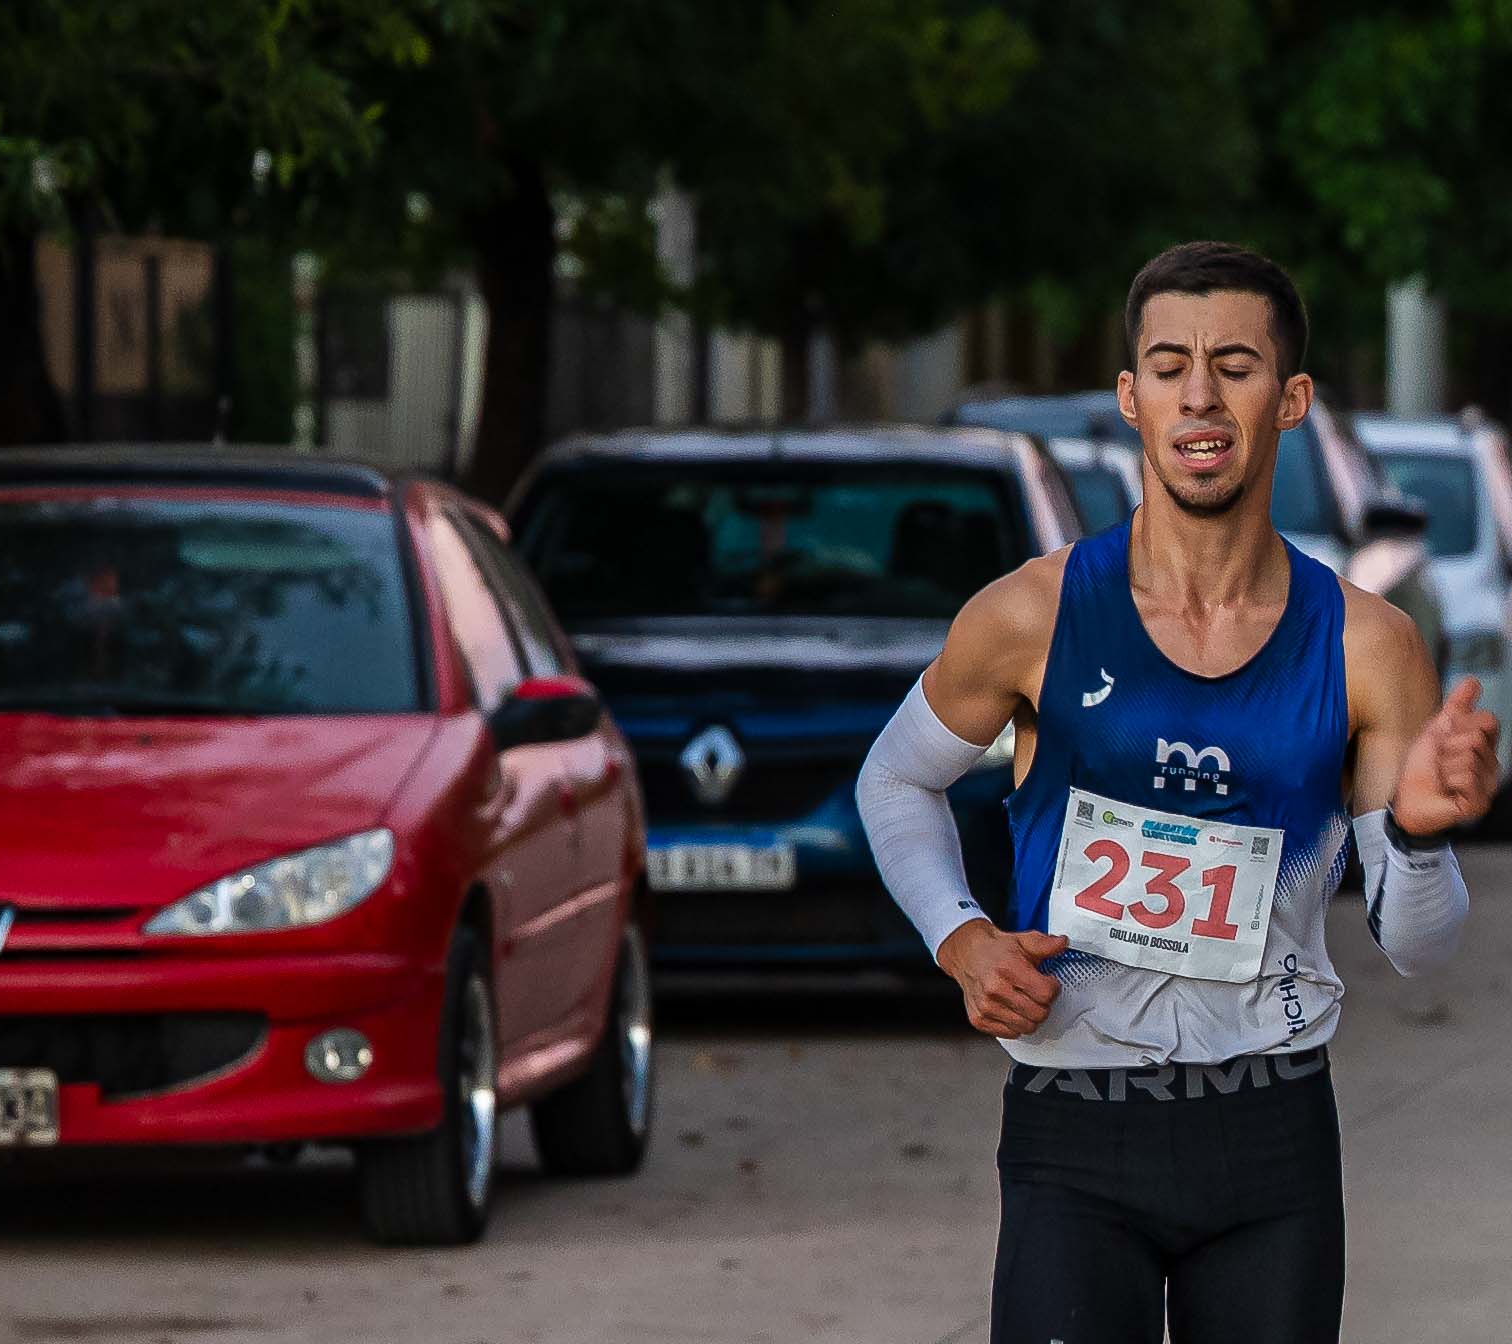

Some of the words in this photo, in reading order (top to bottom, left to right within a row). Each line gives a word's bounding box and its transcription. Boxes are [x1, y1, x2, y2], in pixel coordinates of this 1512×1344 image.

[1161, 766, 1221, 783] running
[1074, 838, 1239, 941] 231
[1109, 927, 1150, 946] GIULIANO
[1149, 936, 1189, 954] BOSSOLA
